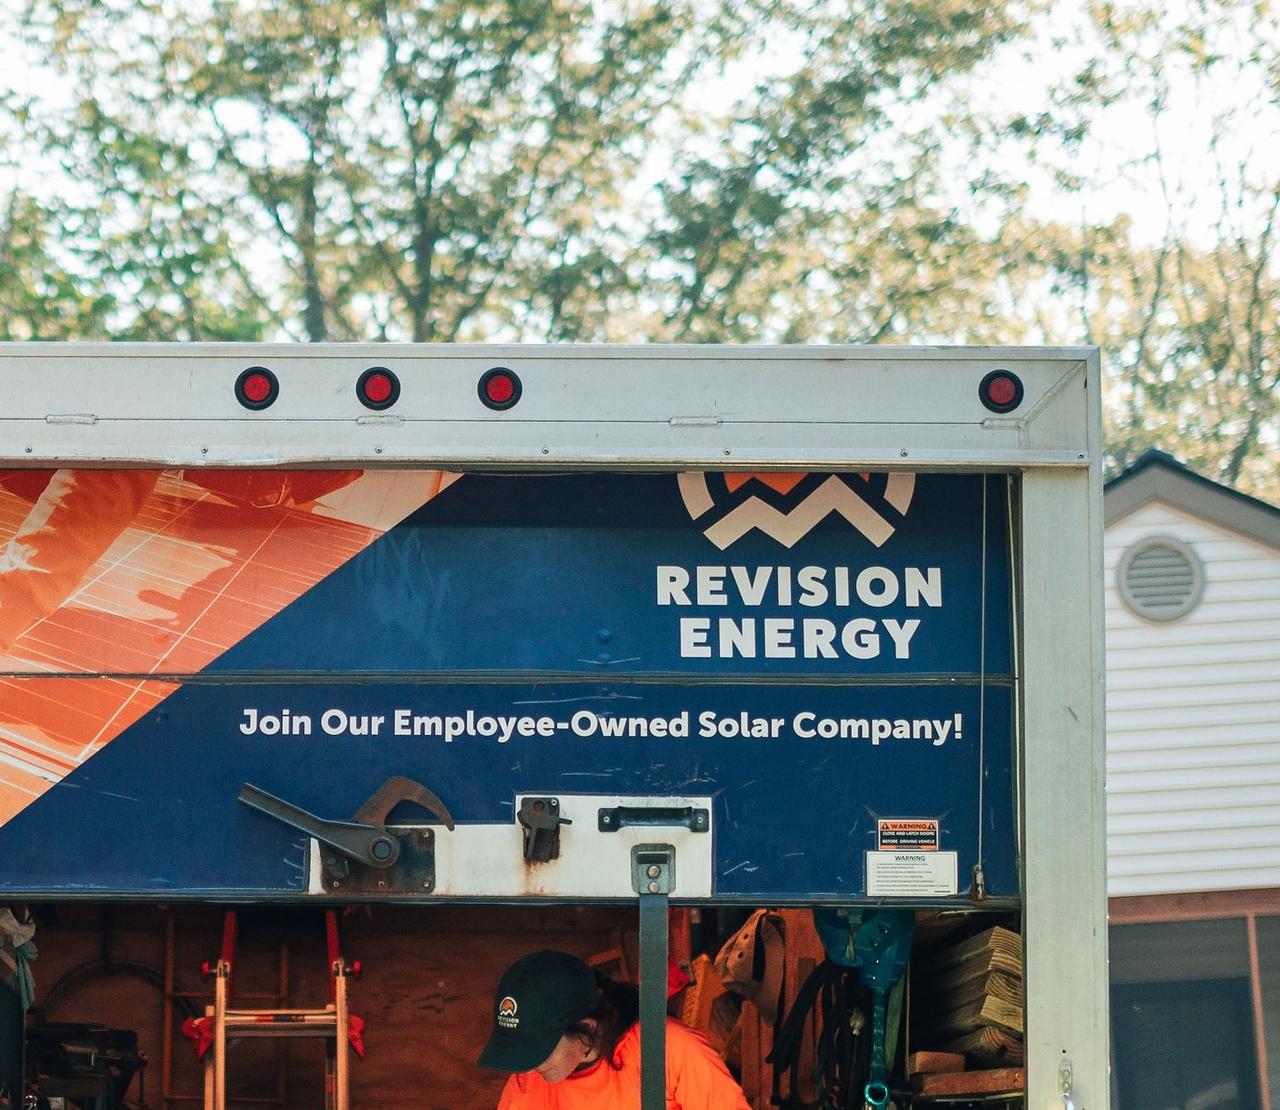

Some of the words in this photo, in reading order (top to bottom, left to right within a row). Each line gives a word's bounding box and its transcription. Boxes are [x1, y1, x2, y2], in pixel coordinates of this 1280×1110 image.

[656, 566, 942, 607] REVISION
[680, 618, 921, 659] ENERGY
[239, 709, 311, 736] Join
[320, 709, 384, 736] Our
[394, 709, 689, 742] Employee-Owned
[698, 710, 784, 738] Solar
[792, 711, 962, 746] Company!
